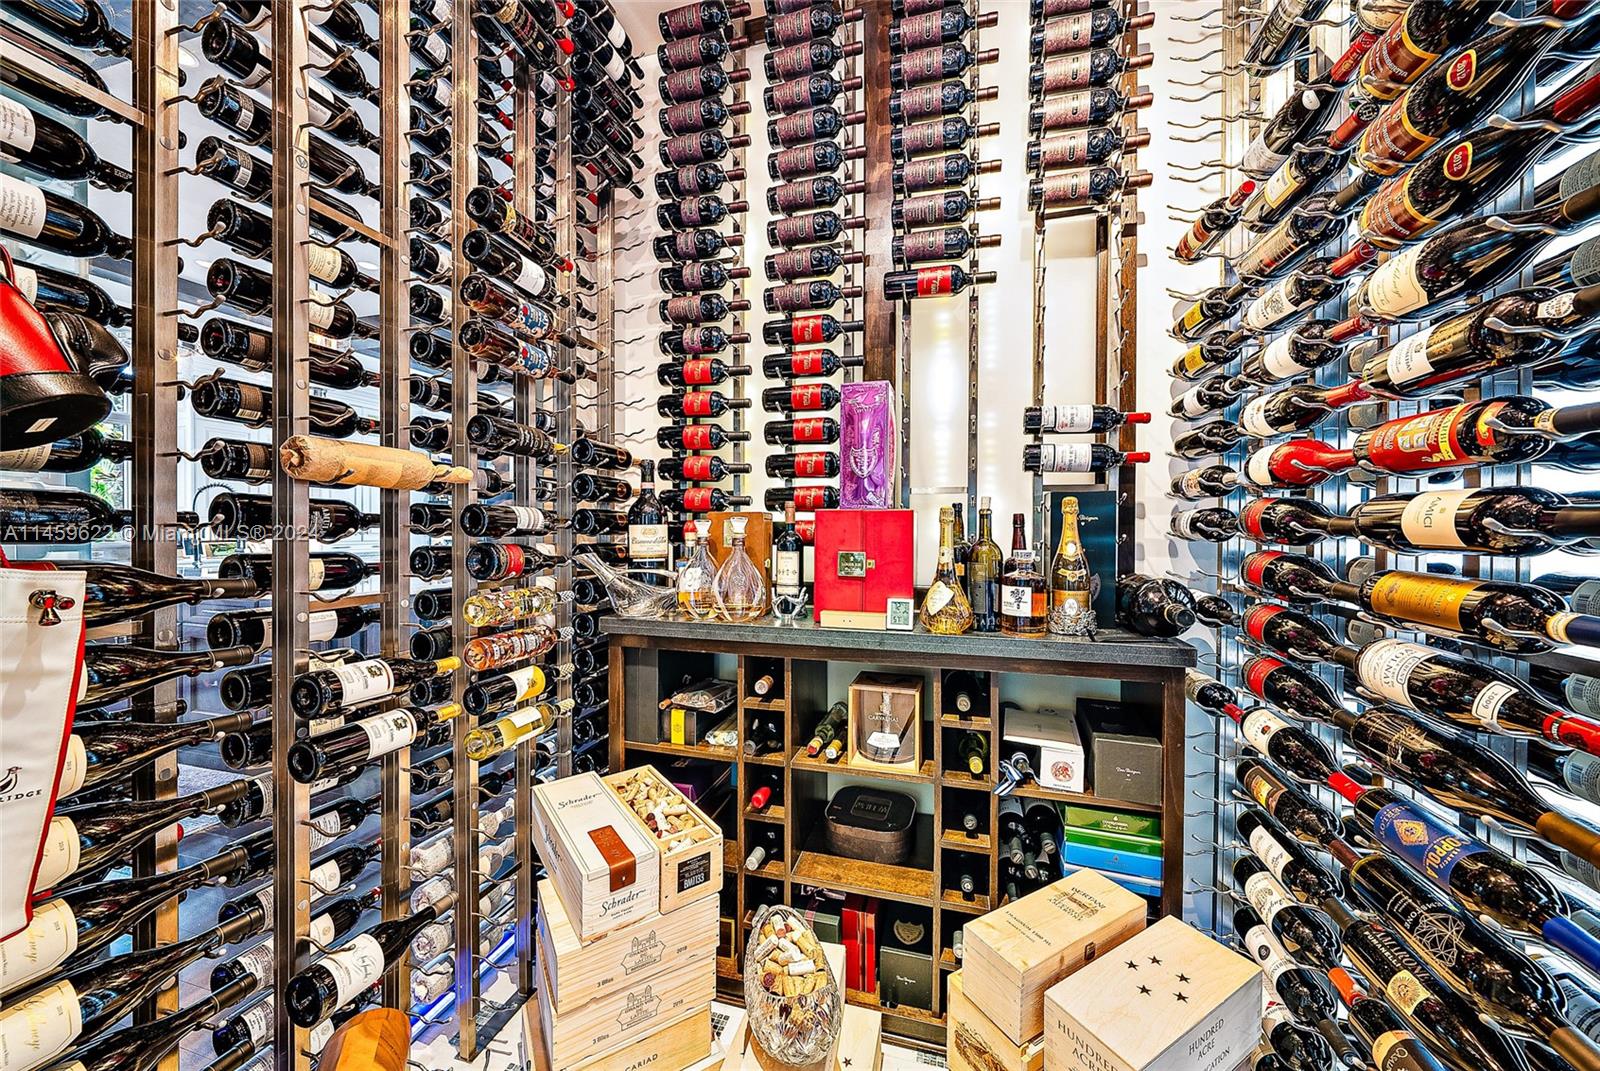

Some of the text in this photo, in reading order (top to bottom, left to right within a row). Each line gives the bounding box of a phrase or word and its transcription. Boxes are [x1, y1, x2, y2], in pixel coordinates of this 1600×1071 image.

[1457, 59, 1467, 81] 2012
[1453, 151, 1463, 172] 2012
[1423, 496, 1441, 528] AMICI
[1383, 648, 1414, 686] VOLNAY
[1484, 690, 1498, 710] 2009
[558, 792, 602, 810] Schrader
[1379, 804, 1411, 839] MERLOT
[1425, 836, 1471, 879] COPPOLA
[599, 889, 647, 917] Schrader
[1071, 887, 1107, 910] BERTANI
[1363, 930, 1401, 967] FUMANELLI
[1188, 1018, 1224, 1056] HUNDRED
[1197, 1037, 1216, 1061] ACRE
[625, 1053, 659, 1071] CARIAD
